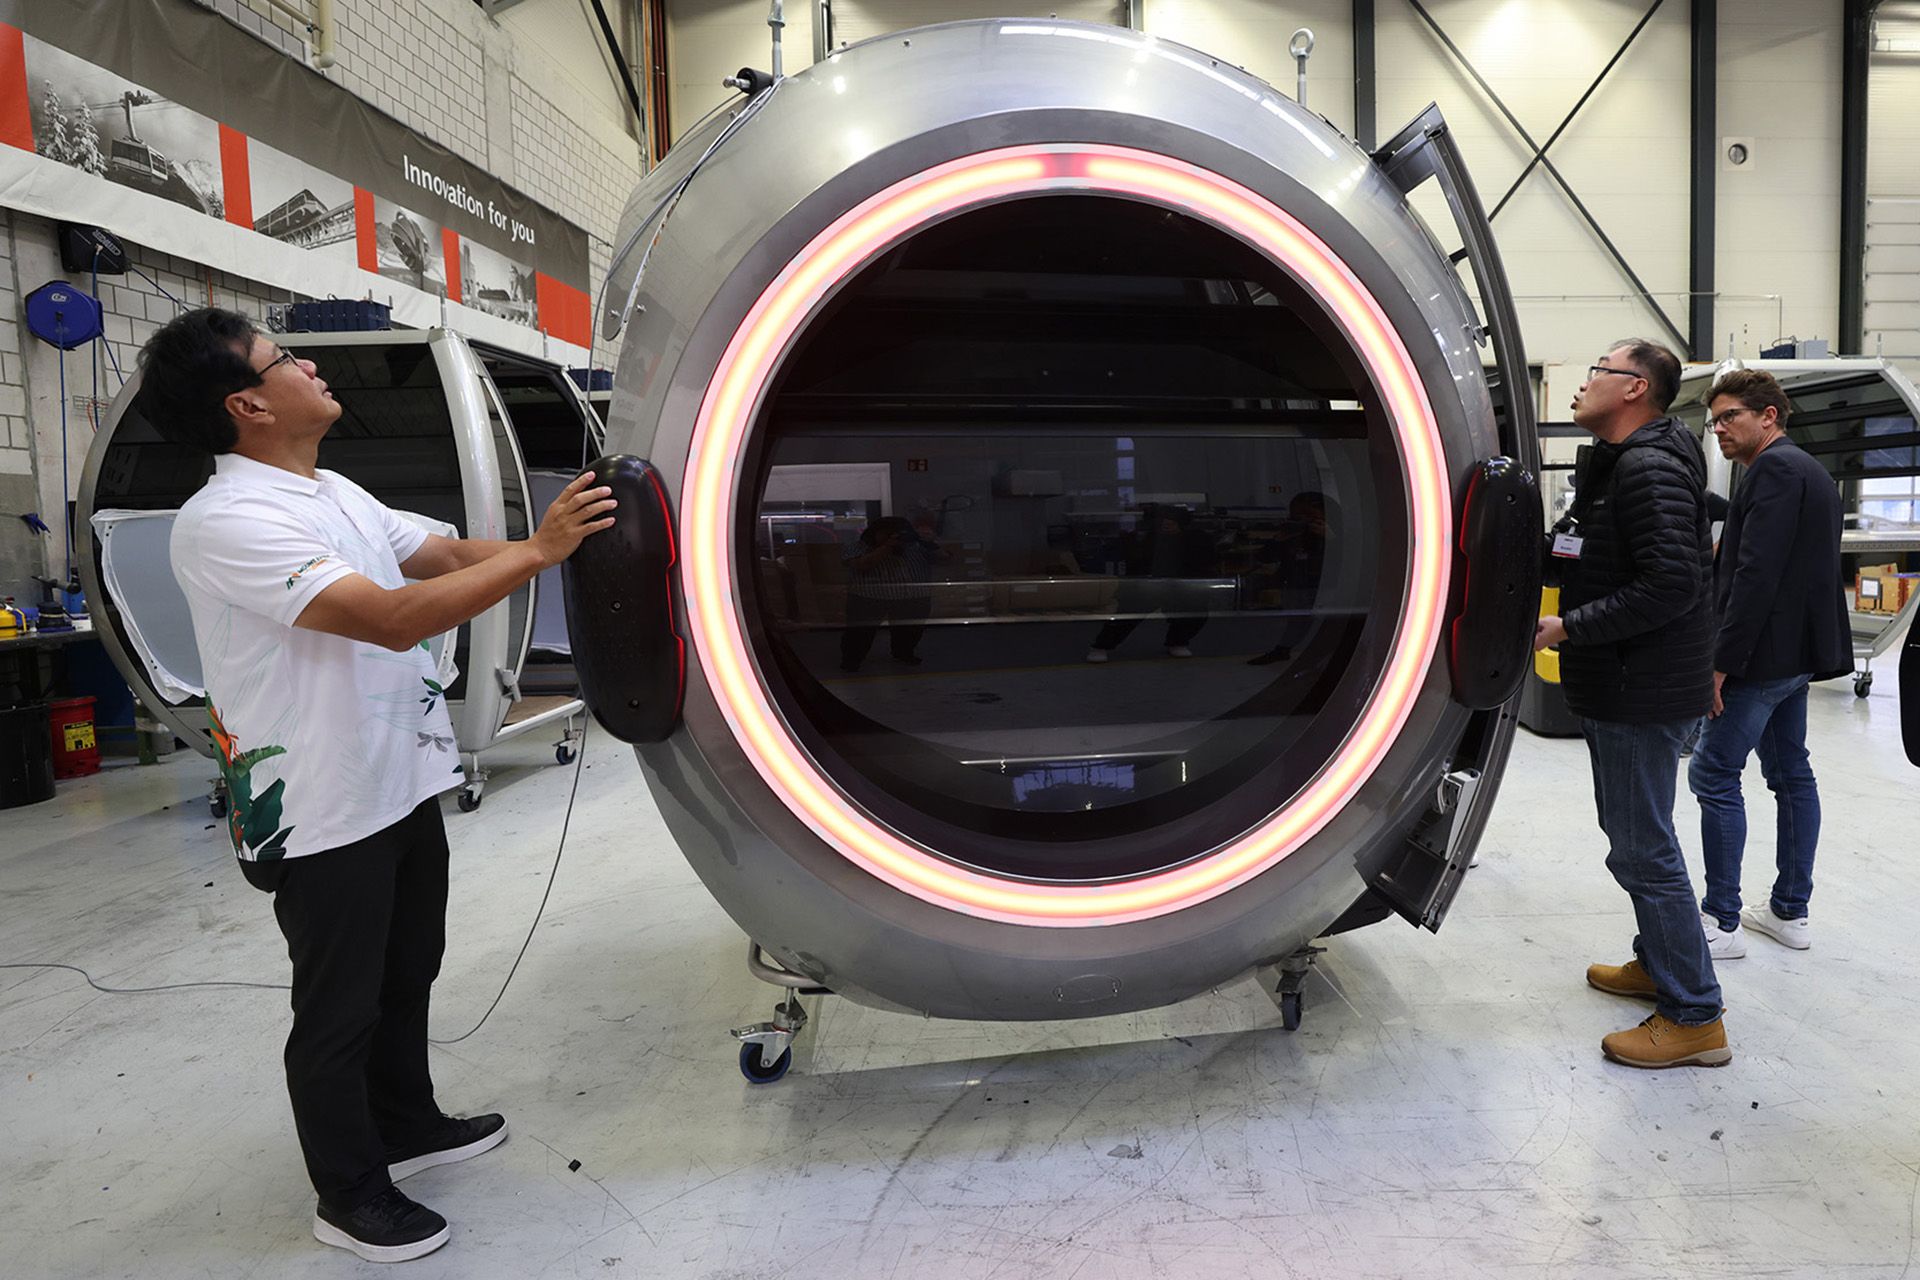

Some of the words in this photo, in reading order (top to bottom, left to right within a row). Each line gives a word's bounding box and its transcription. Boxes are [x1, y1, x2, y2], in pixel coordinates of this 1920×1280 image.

[403, 154, 485, 220] Innovation
[487, 201, 508, 231] for
[511, 219, 536, 245] you
